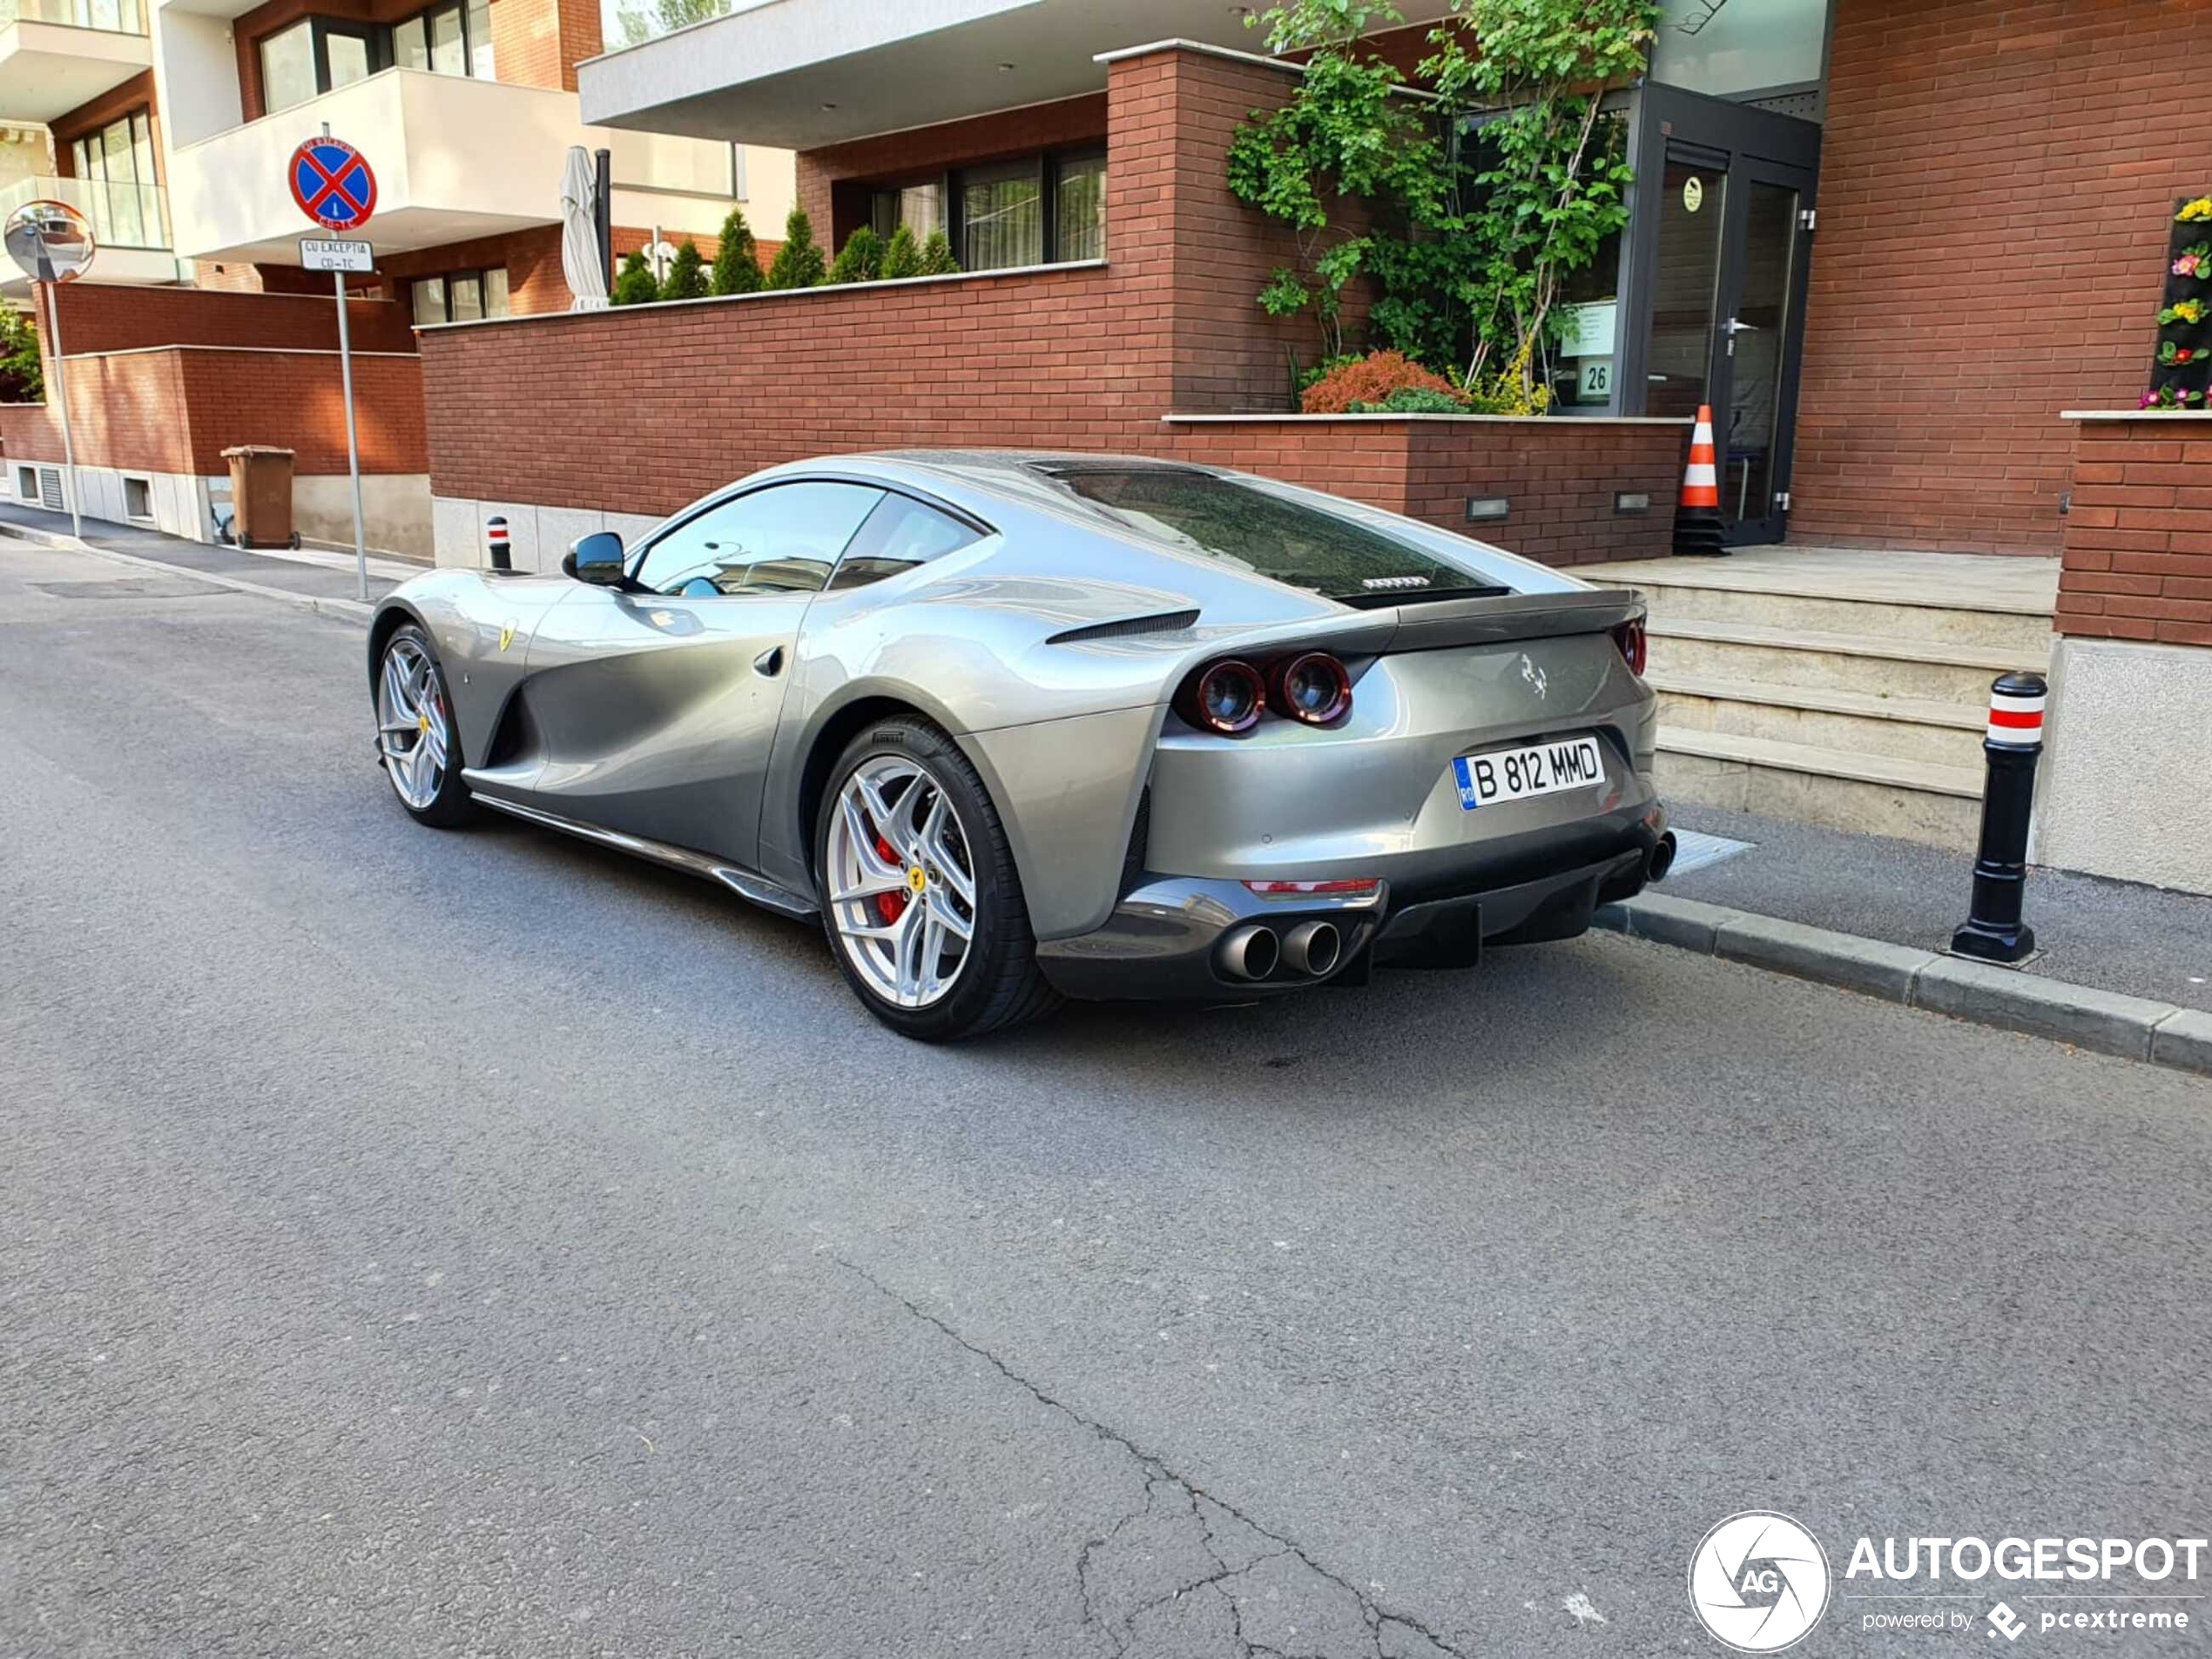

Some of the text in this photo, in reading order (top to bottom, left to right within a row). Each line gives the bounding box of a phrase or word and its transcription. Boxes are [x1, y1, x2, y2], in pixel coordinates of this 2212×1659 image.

[305, 241, 367, 253] CU EXCEPTIA
[320, 258, 354, 269] CD-TC
[1588, 367, 1606, 390] 26
[1474, 743, 1598, 799] B 812 MMD
[1460, 787, 1474, 803] RO
